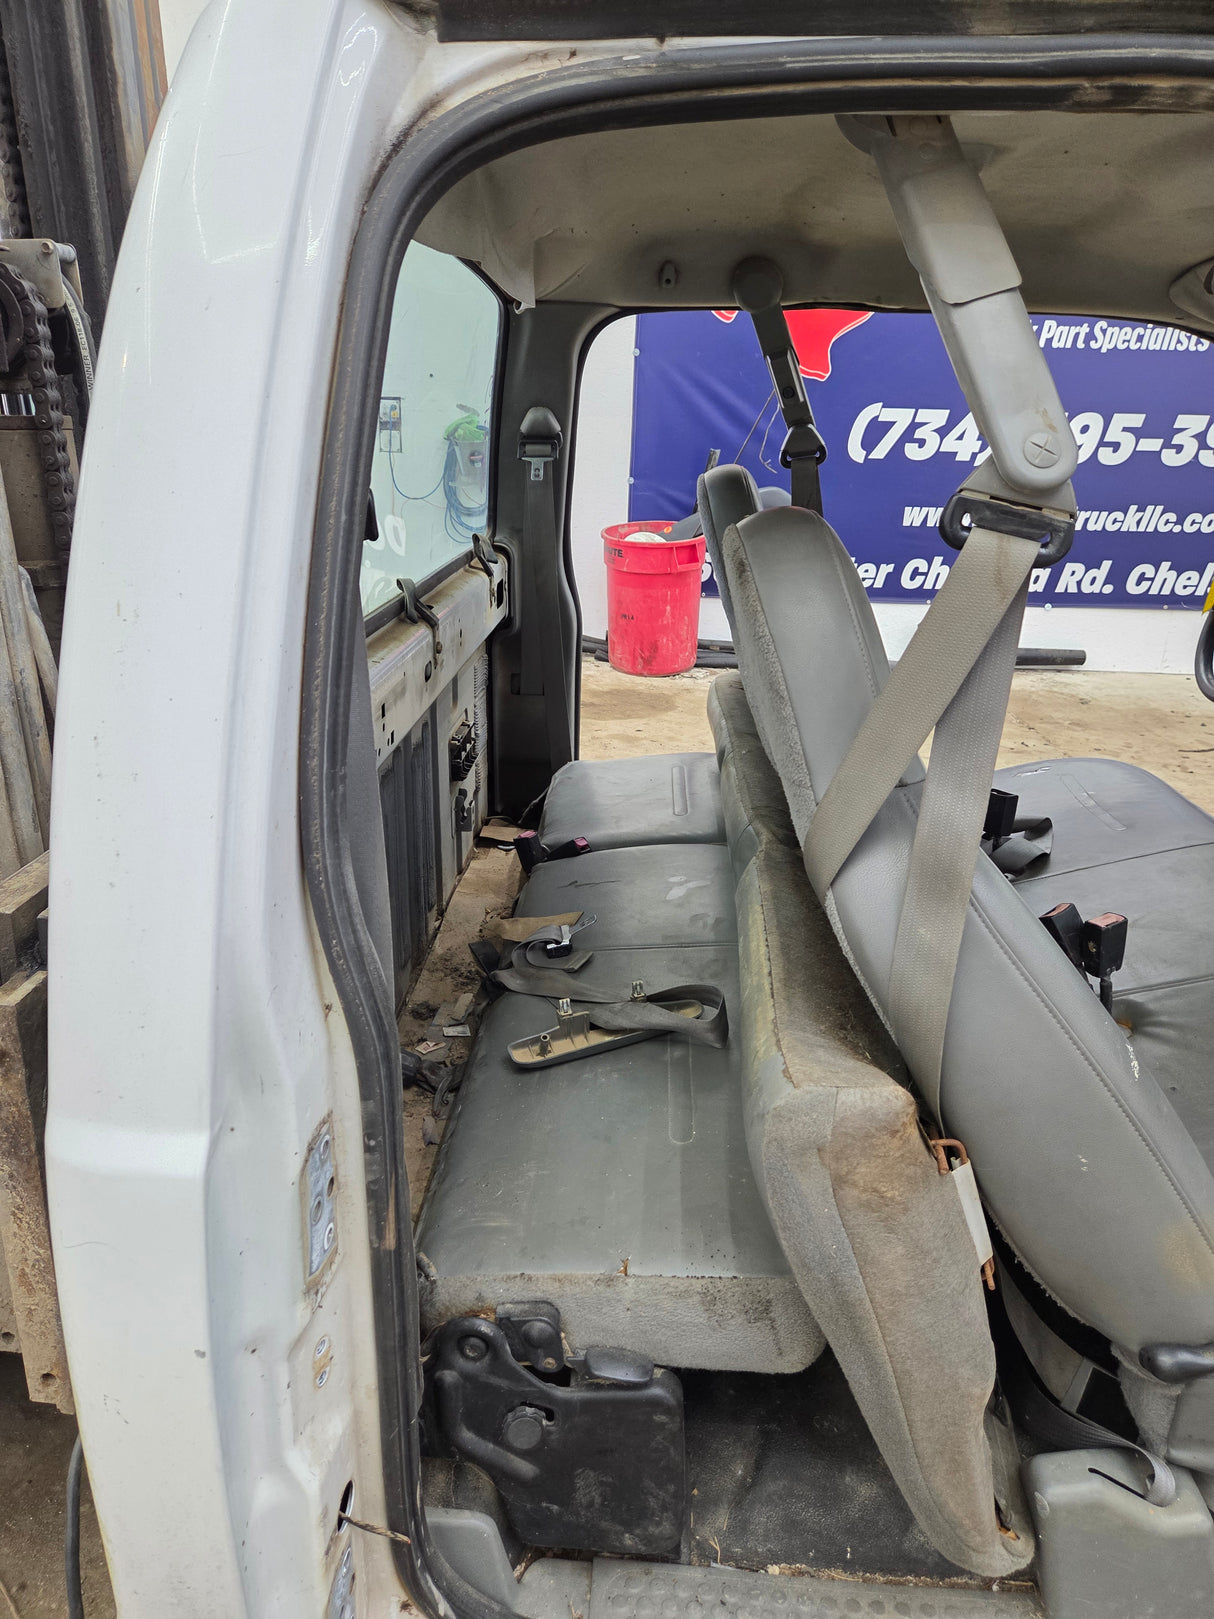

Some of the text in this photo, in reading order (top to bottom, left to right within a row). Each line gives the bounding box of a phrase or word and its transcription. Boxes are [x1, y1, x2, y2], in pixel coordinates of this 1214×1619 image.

[1039, 319, 1090, 350] Part
[1089, 320, 1210, 353] Specialists
[83, 354, 94, 391] WINNER
[1054, 559, 1114, 595] Rd.
[1125, 561, 1214, 597] Chel
